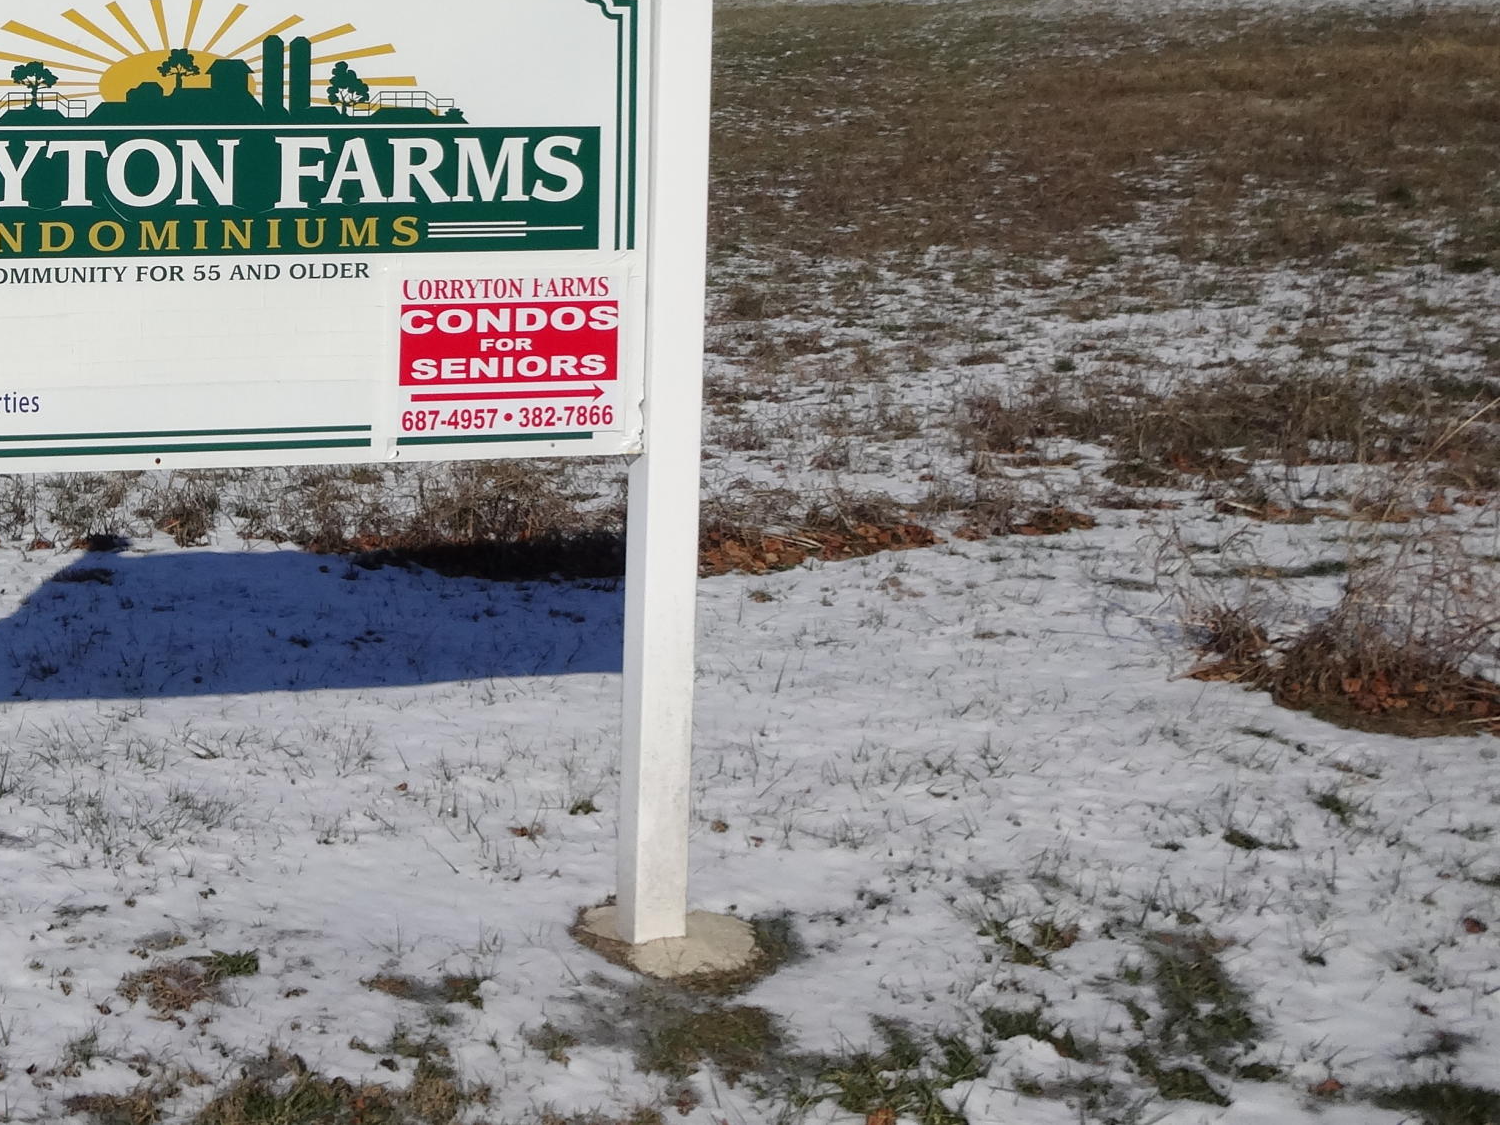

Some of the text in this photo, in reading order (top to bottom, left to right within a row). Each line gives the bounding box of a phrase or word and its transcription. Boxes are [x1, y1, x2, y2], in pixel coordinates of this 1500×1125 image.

[274, 135, 584, 209] FARMS
[135, 265, 185, 283] FOR
[193, 265, 221, 281] 55
[230, 263, 281, 281] AND
[289, 261, 370, 279] OLDER
[403, 276, 610, 301] CORRYTON FARMS
[401, 306, 618, 335] CONDOS
[480, 338, 533, 352] FOR
[411, 354, 607, 380] SENIORS
